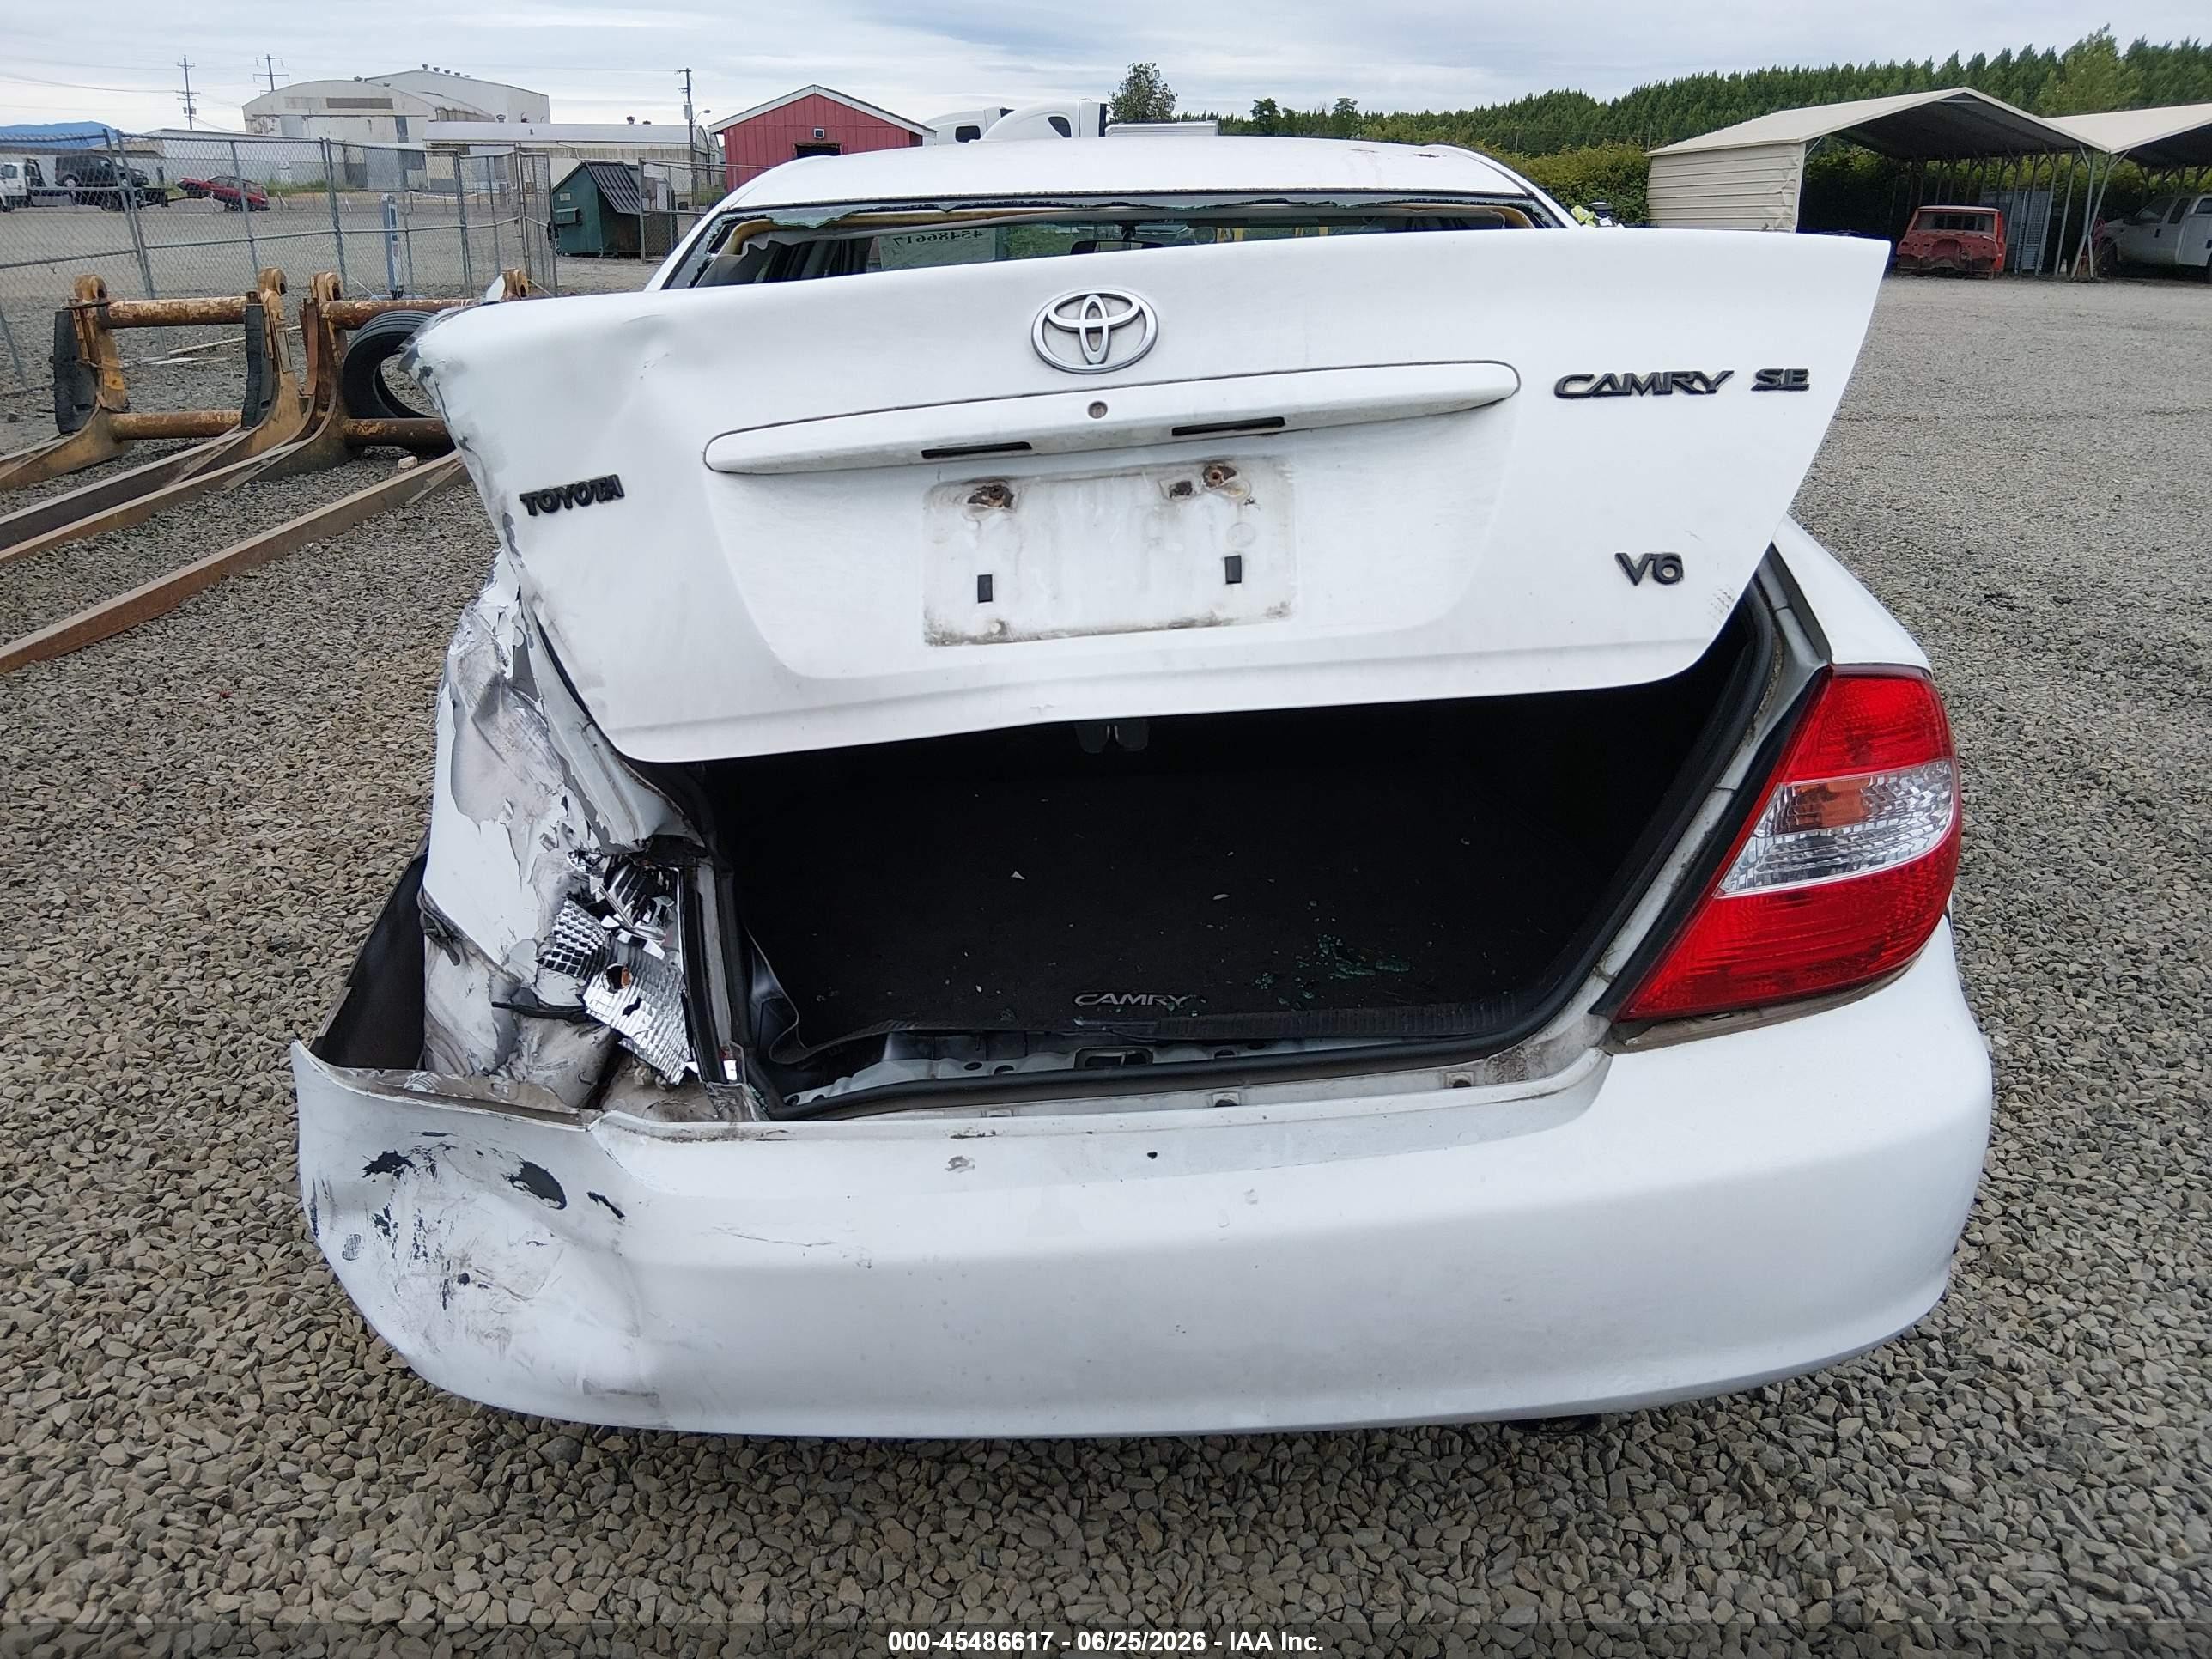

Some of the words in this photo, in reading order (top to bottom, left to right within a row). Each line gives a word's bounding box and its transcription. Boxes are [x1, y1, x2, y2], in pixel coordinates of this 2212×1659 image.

[1554, 370, 1735, 399] CAMRY
[1750, 368, 1810, 392] SE
[519, 473, 625, 516] TOYOTA
[1615, 552, 1684, 586] V6
[1074, 993, 1188, 1006] CAMRY
